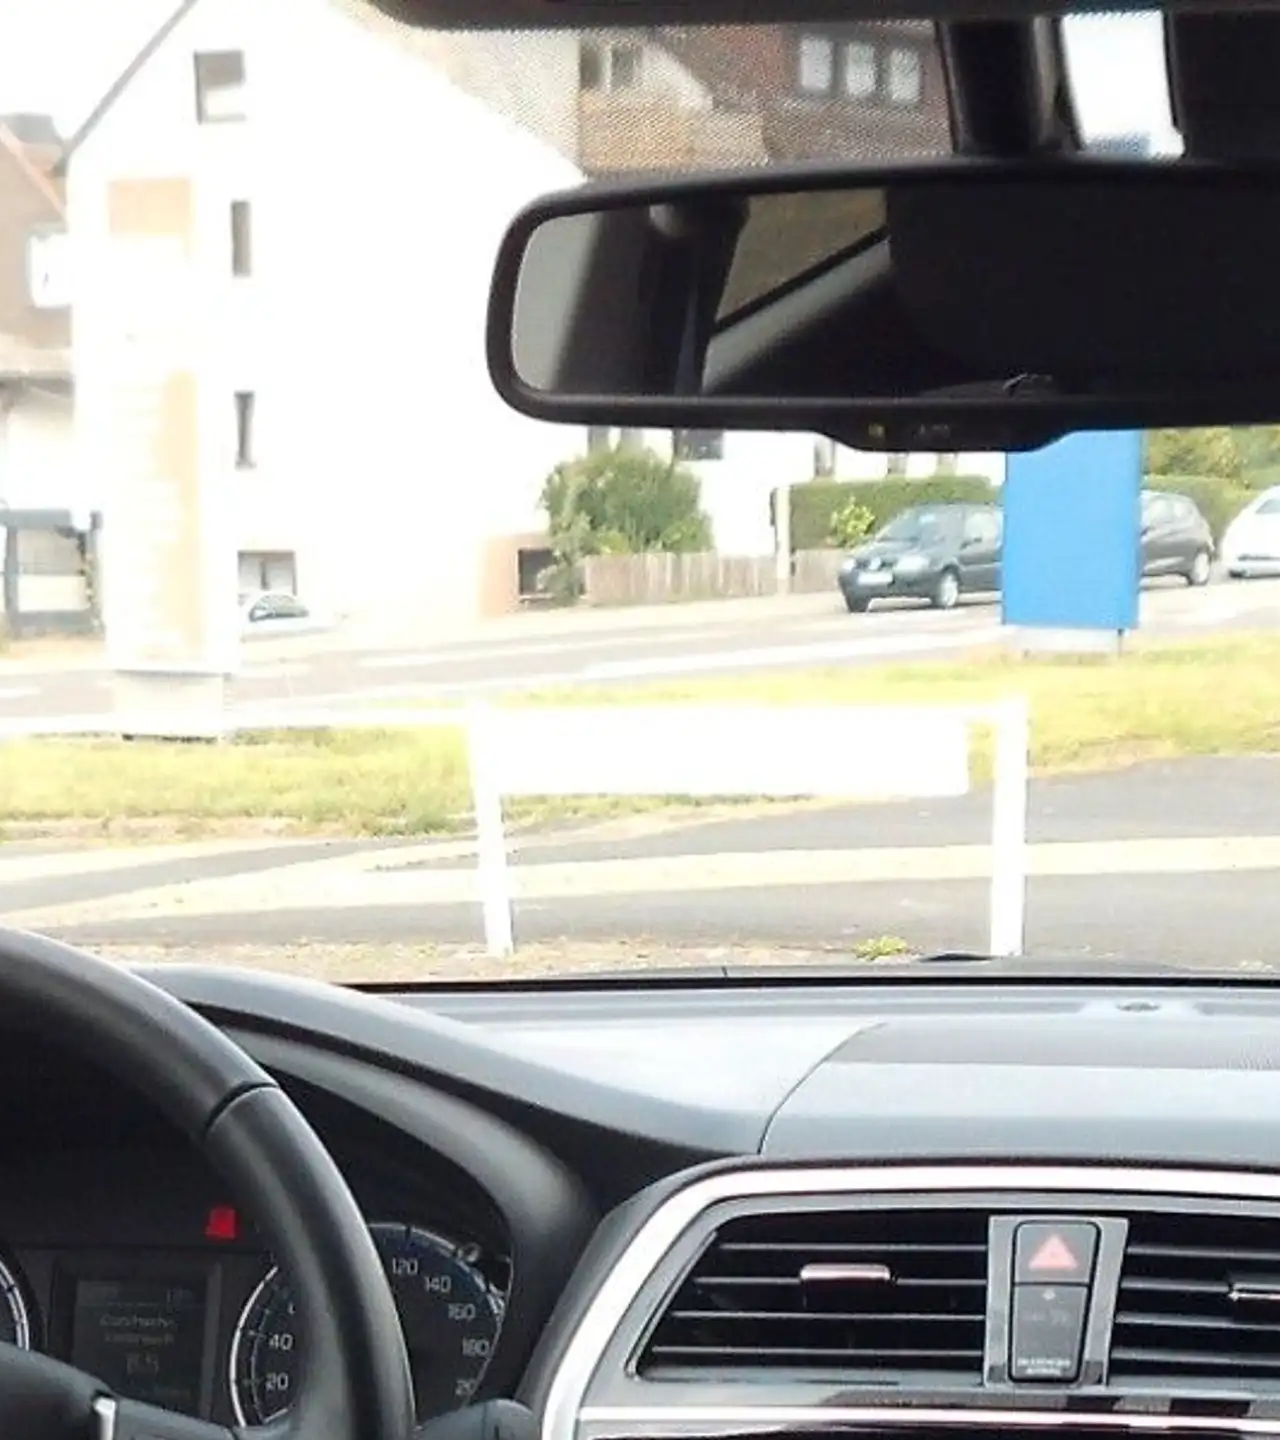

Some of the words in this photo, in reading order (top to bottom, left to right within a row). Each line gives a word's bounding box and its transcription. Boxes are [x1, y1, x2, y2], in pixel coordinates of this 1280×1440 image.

[392, 1258, 420, 1276] 120
[424, 1276, 452, 1293] 140
[448, 1304, 476, 1321] 160
[269, 1333, 293, 1350] 40
[266, 1373, 289, 1391] 20
